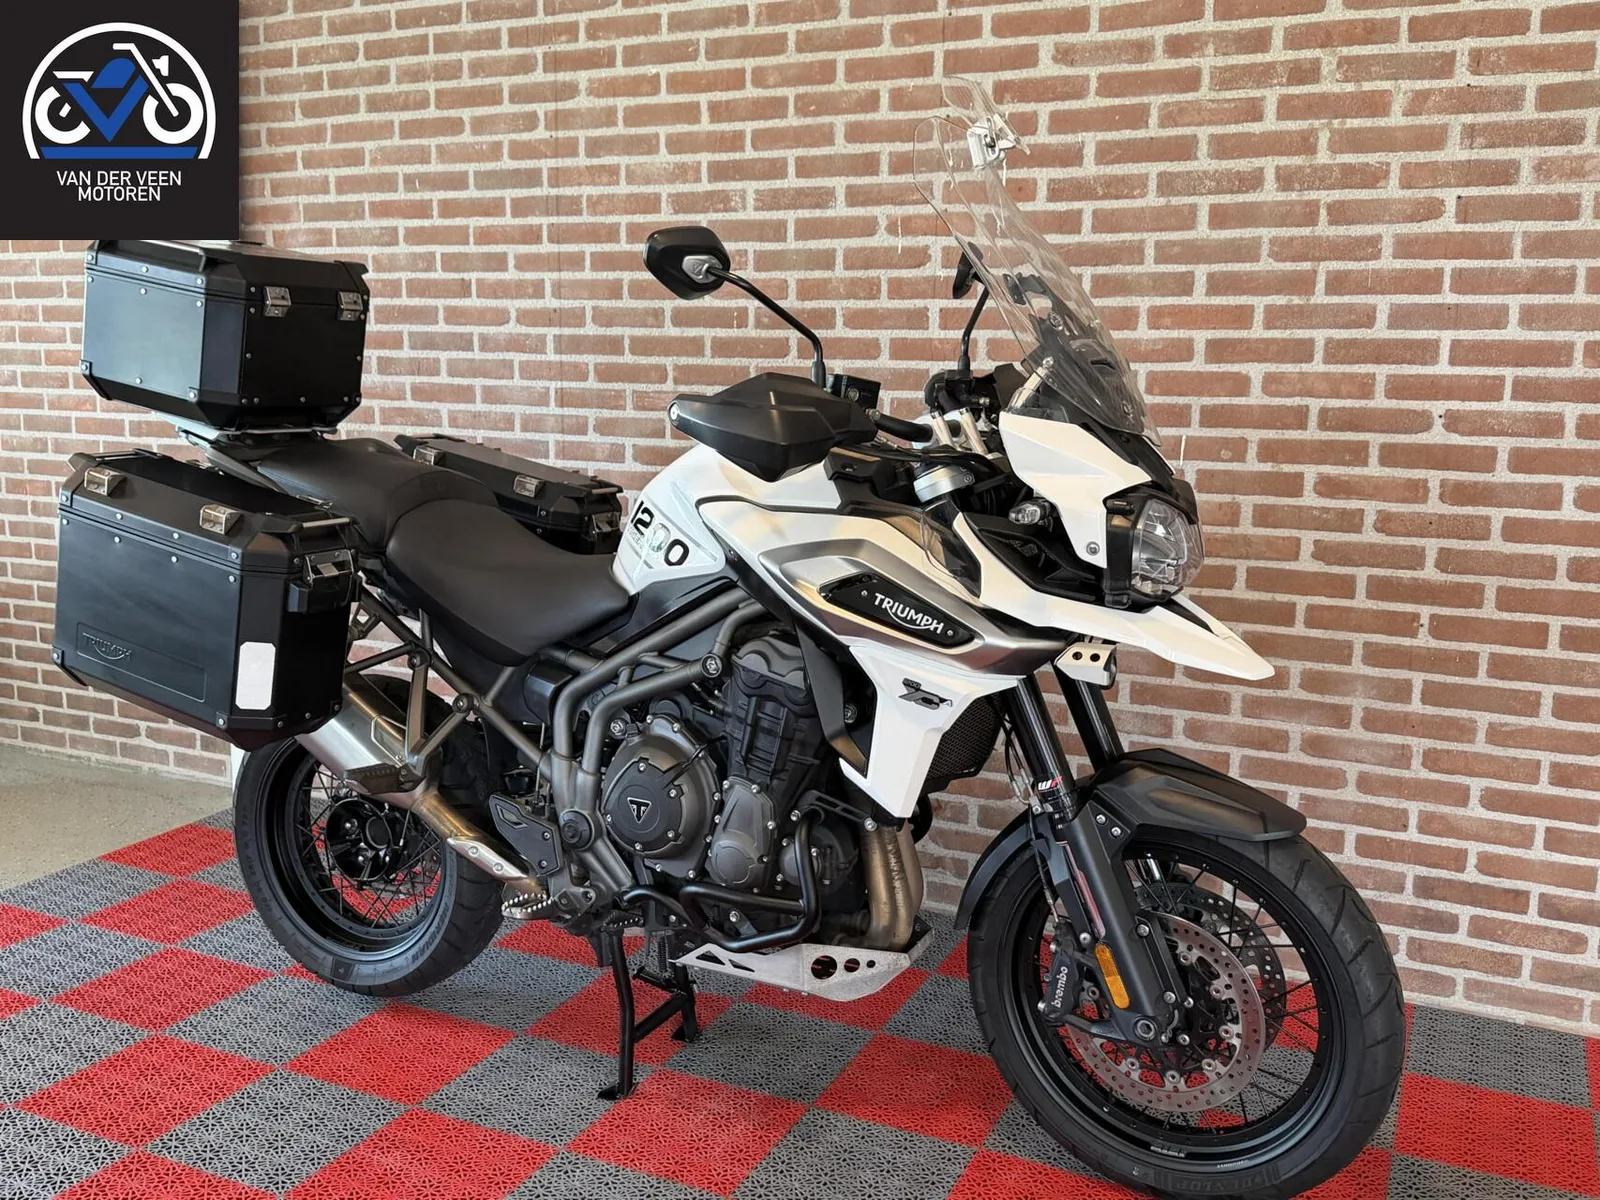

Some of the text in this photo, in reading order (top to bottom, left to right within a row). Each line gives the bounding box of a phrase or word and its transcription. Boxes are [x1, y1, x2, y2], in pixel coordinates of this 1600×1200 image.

[630, 500, 690, 567] 1200
[874, 592, 944, 635] TRIUMPH
[82, 632, 132, 662] TRIUMPH
[1051, 966, 1068, 1008] brembo
